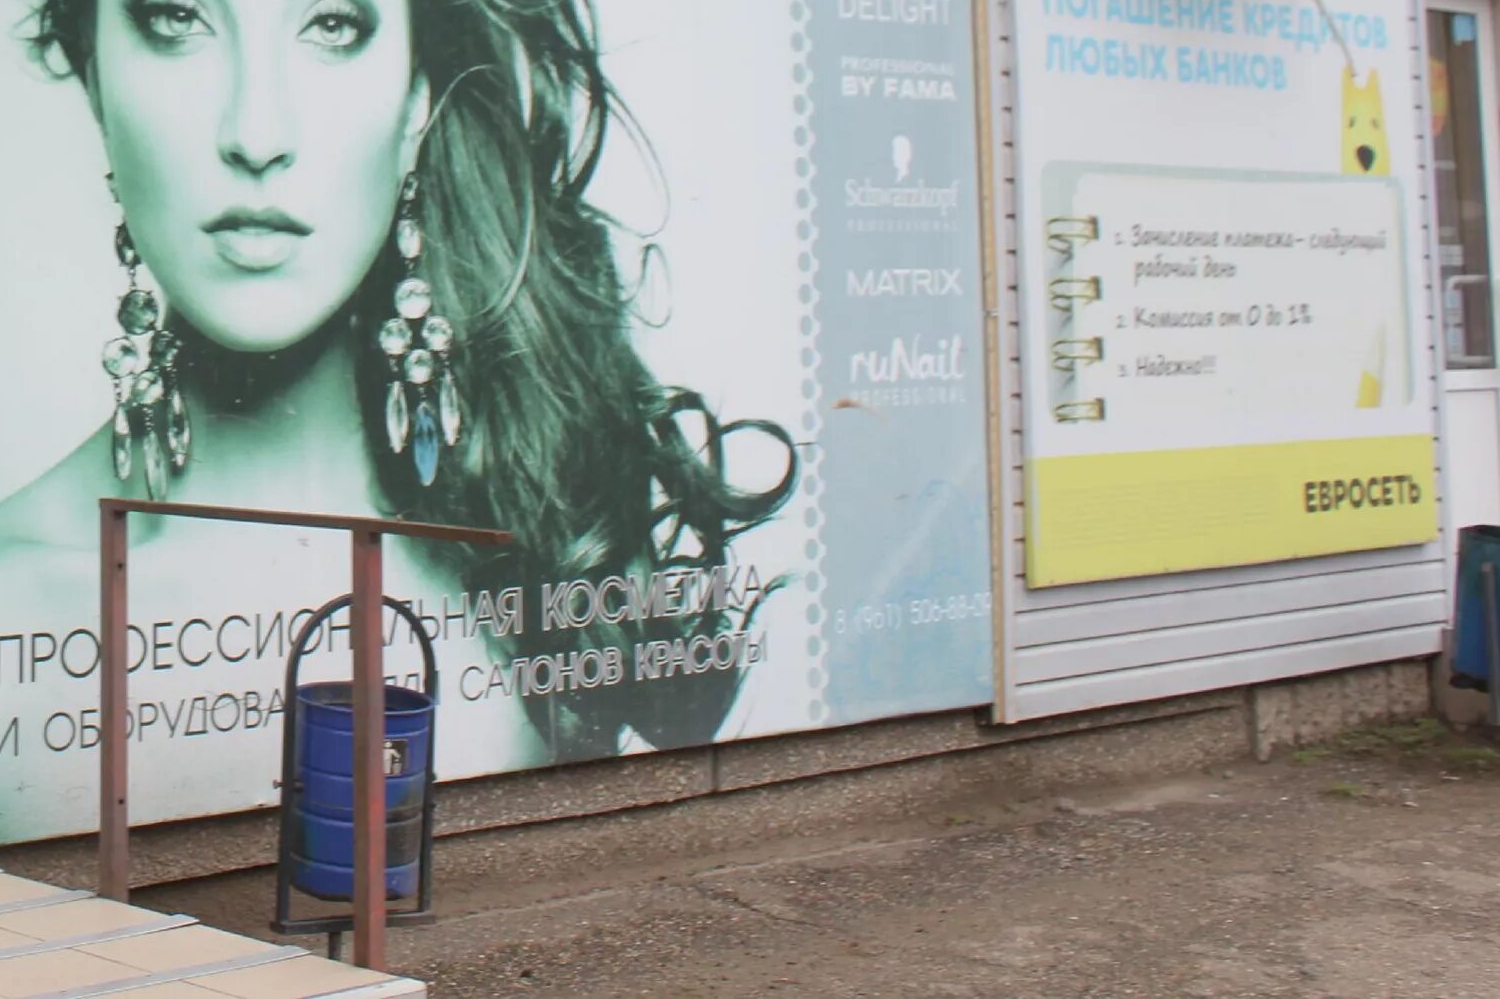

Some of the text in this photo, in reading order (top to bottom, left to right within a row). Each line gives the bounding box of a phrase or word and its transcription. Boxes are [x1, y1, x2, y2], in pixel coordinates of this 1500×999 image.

[1244, 2, 1389, 53] КРЕДИТОВ
[1045, 33, 1288, 90] ЛЮБЫХ БАНКОВ
[841, 75, 956, 101] BY FAMA
[1130, 223, 1219, 248] Зачисление
[1309, 227, 1388, 255] следующий
[846, 268, 964, 296] MATRIX
[1133, 253, 1237, 286] рабочий день
[1133, 306, 1215, 328] Комиссия
[1219, 309, 1244, 328] от
[1266, 303, 1284, 326] до
[851, 333, 965, 383] ruNail
[1304, 474, 1422, 513] ЕВРОСЕТЬ
[542, 564, 764, 632] КОСМЕТИКА
[460, 646, 624, 701] САЛОНОВ
[634, 630, 768, 682] КРАСОТЫ
